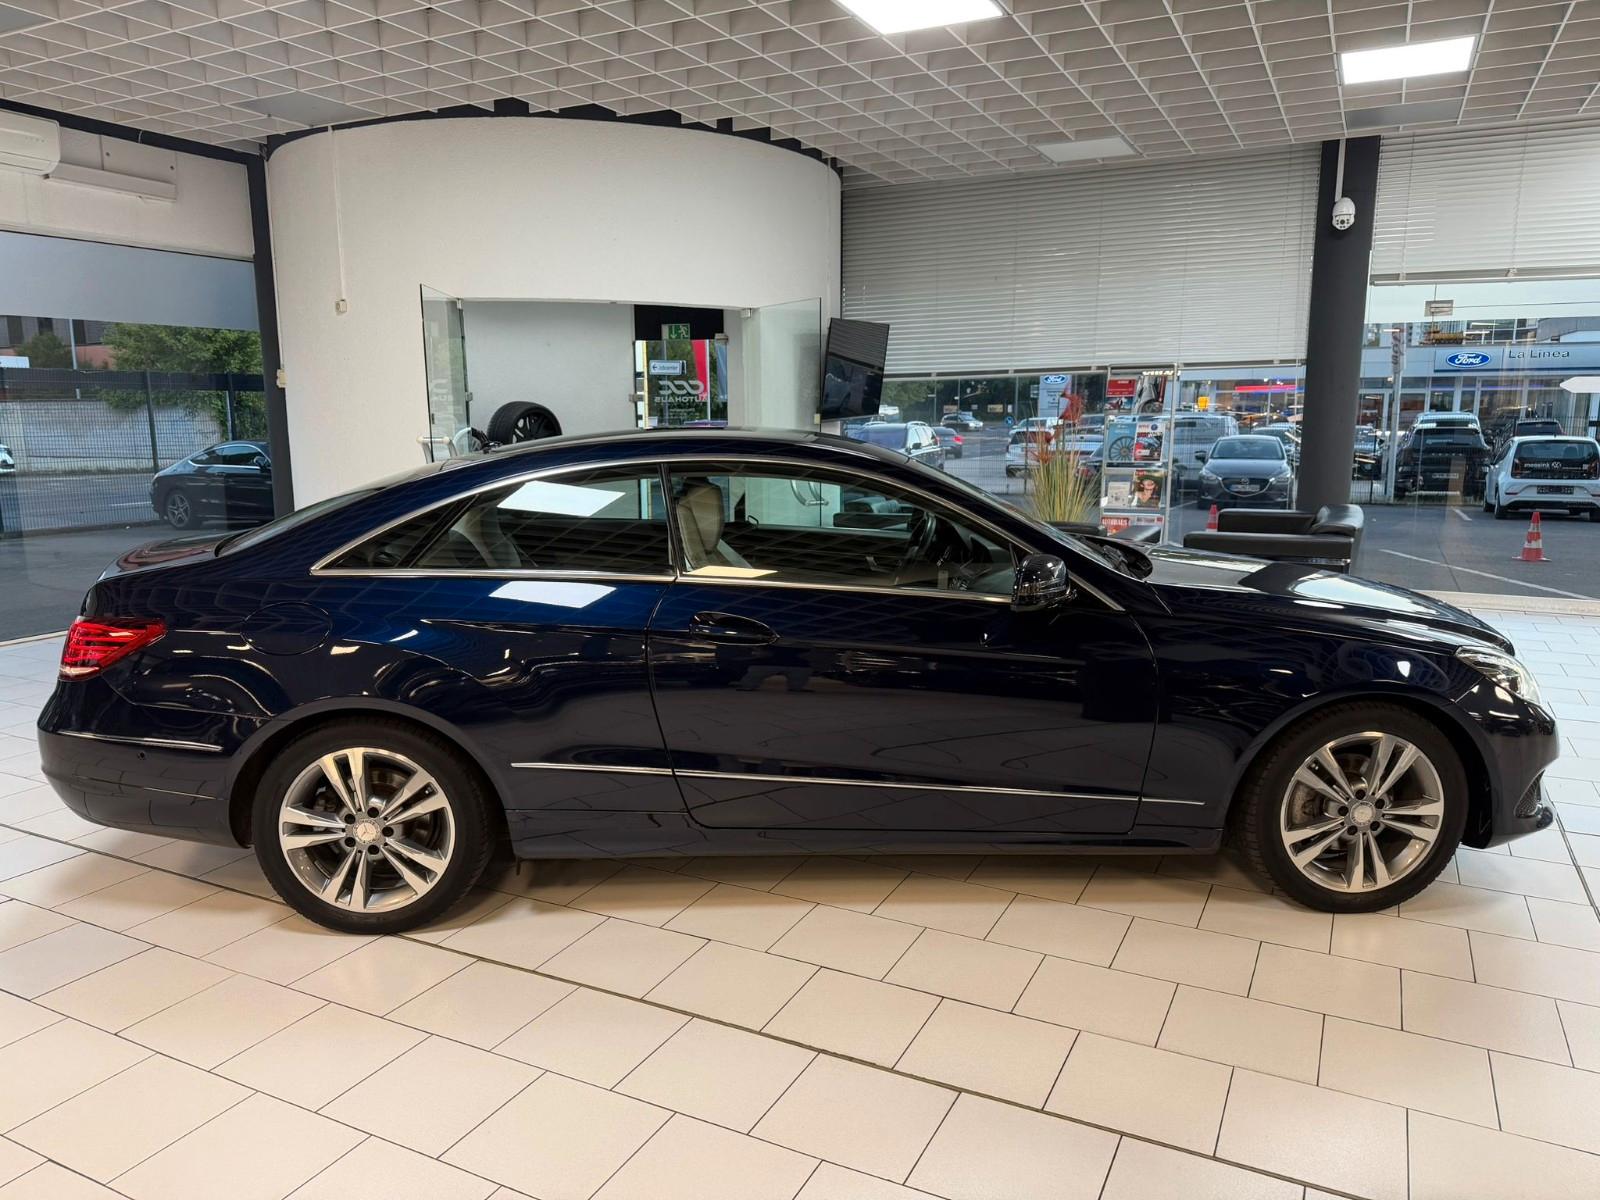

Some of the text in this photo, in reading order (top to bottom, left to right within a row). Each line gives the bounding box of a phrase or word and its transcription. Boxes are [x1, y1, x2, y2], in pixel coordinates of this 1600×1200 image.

[1455, 353, 1482, 365] Ford
[1509, 349, 1570, 359] La Linea
